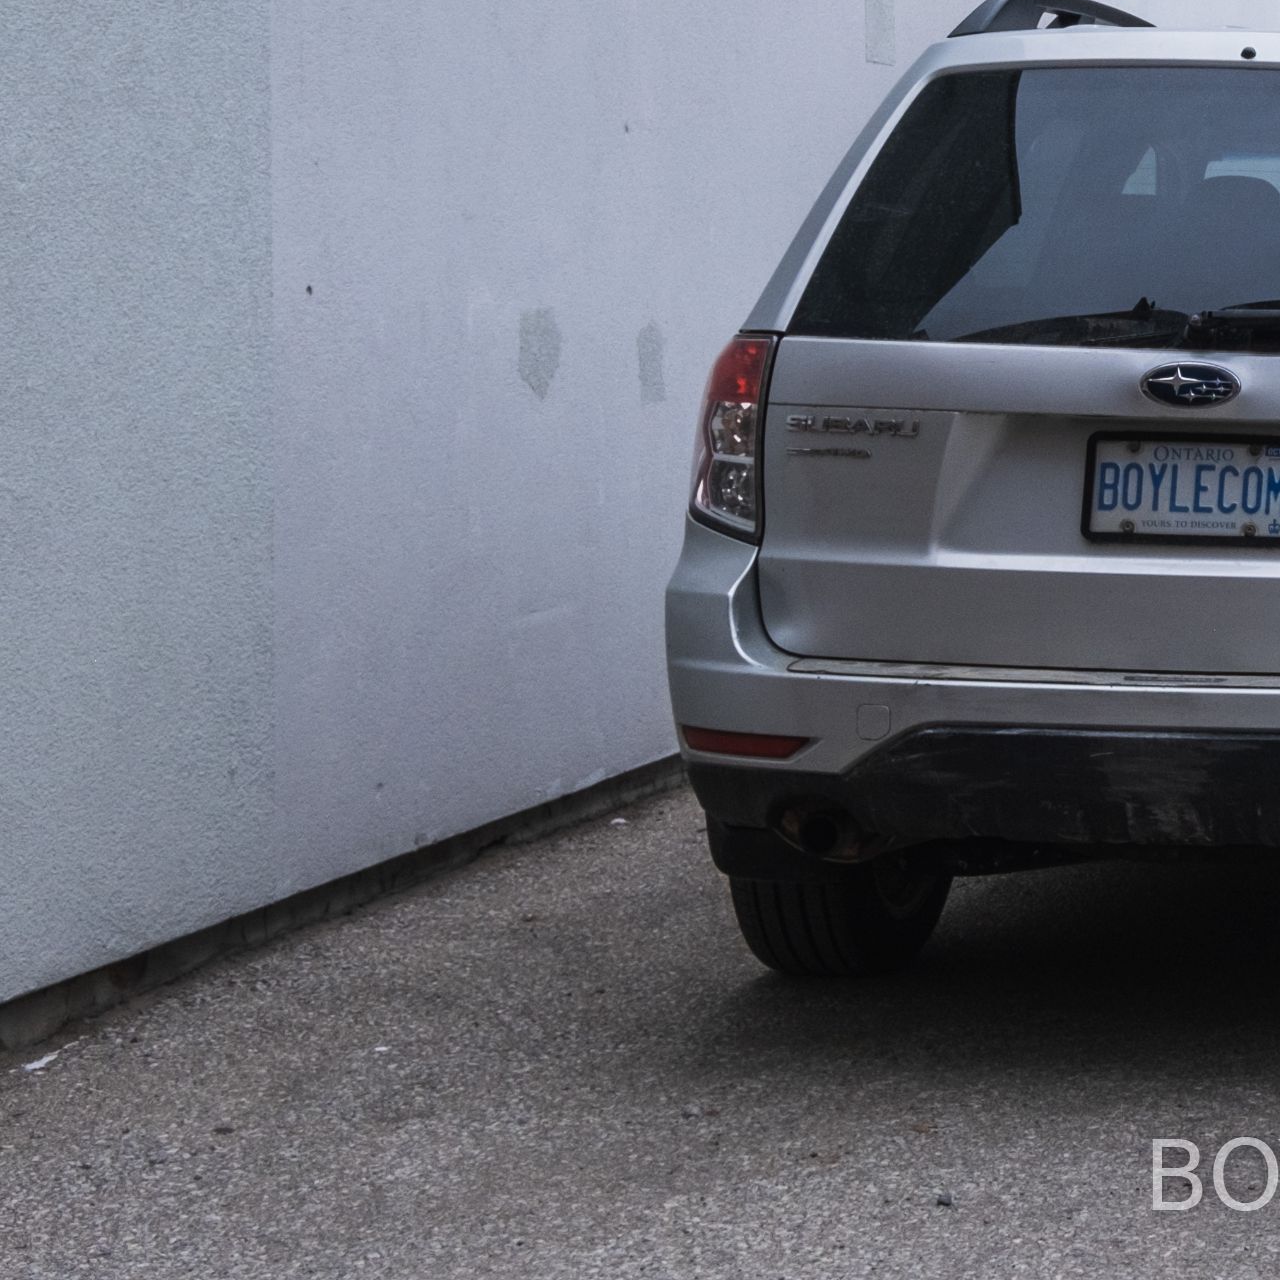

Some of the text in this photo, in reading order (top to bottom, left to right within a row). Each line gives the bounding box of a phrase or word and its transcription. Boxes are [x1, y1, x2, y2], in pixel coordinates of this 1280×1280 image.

[786, 415, 920, 436] SUBARU
[1153, 446, 1235, 463] ONTARIO
[1141, 520, 1237, 530] YOURS TO DISCOVER
